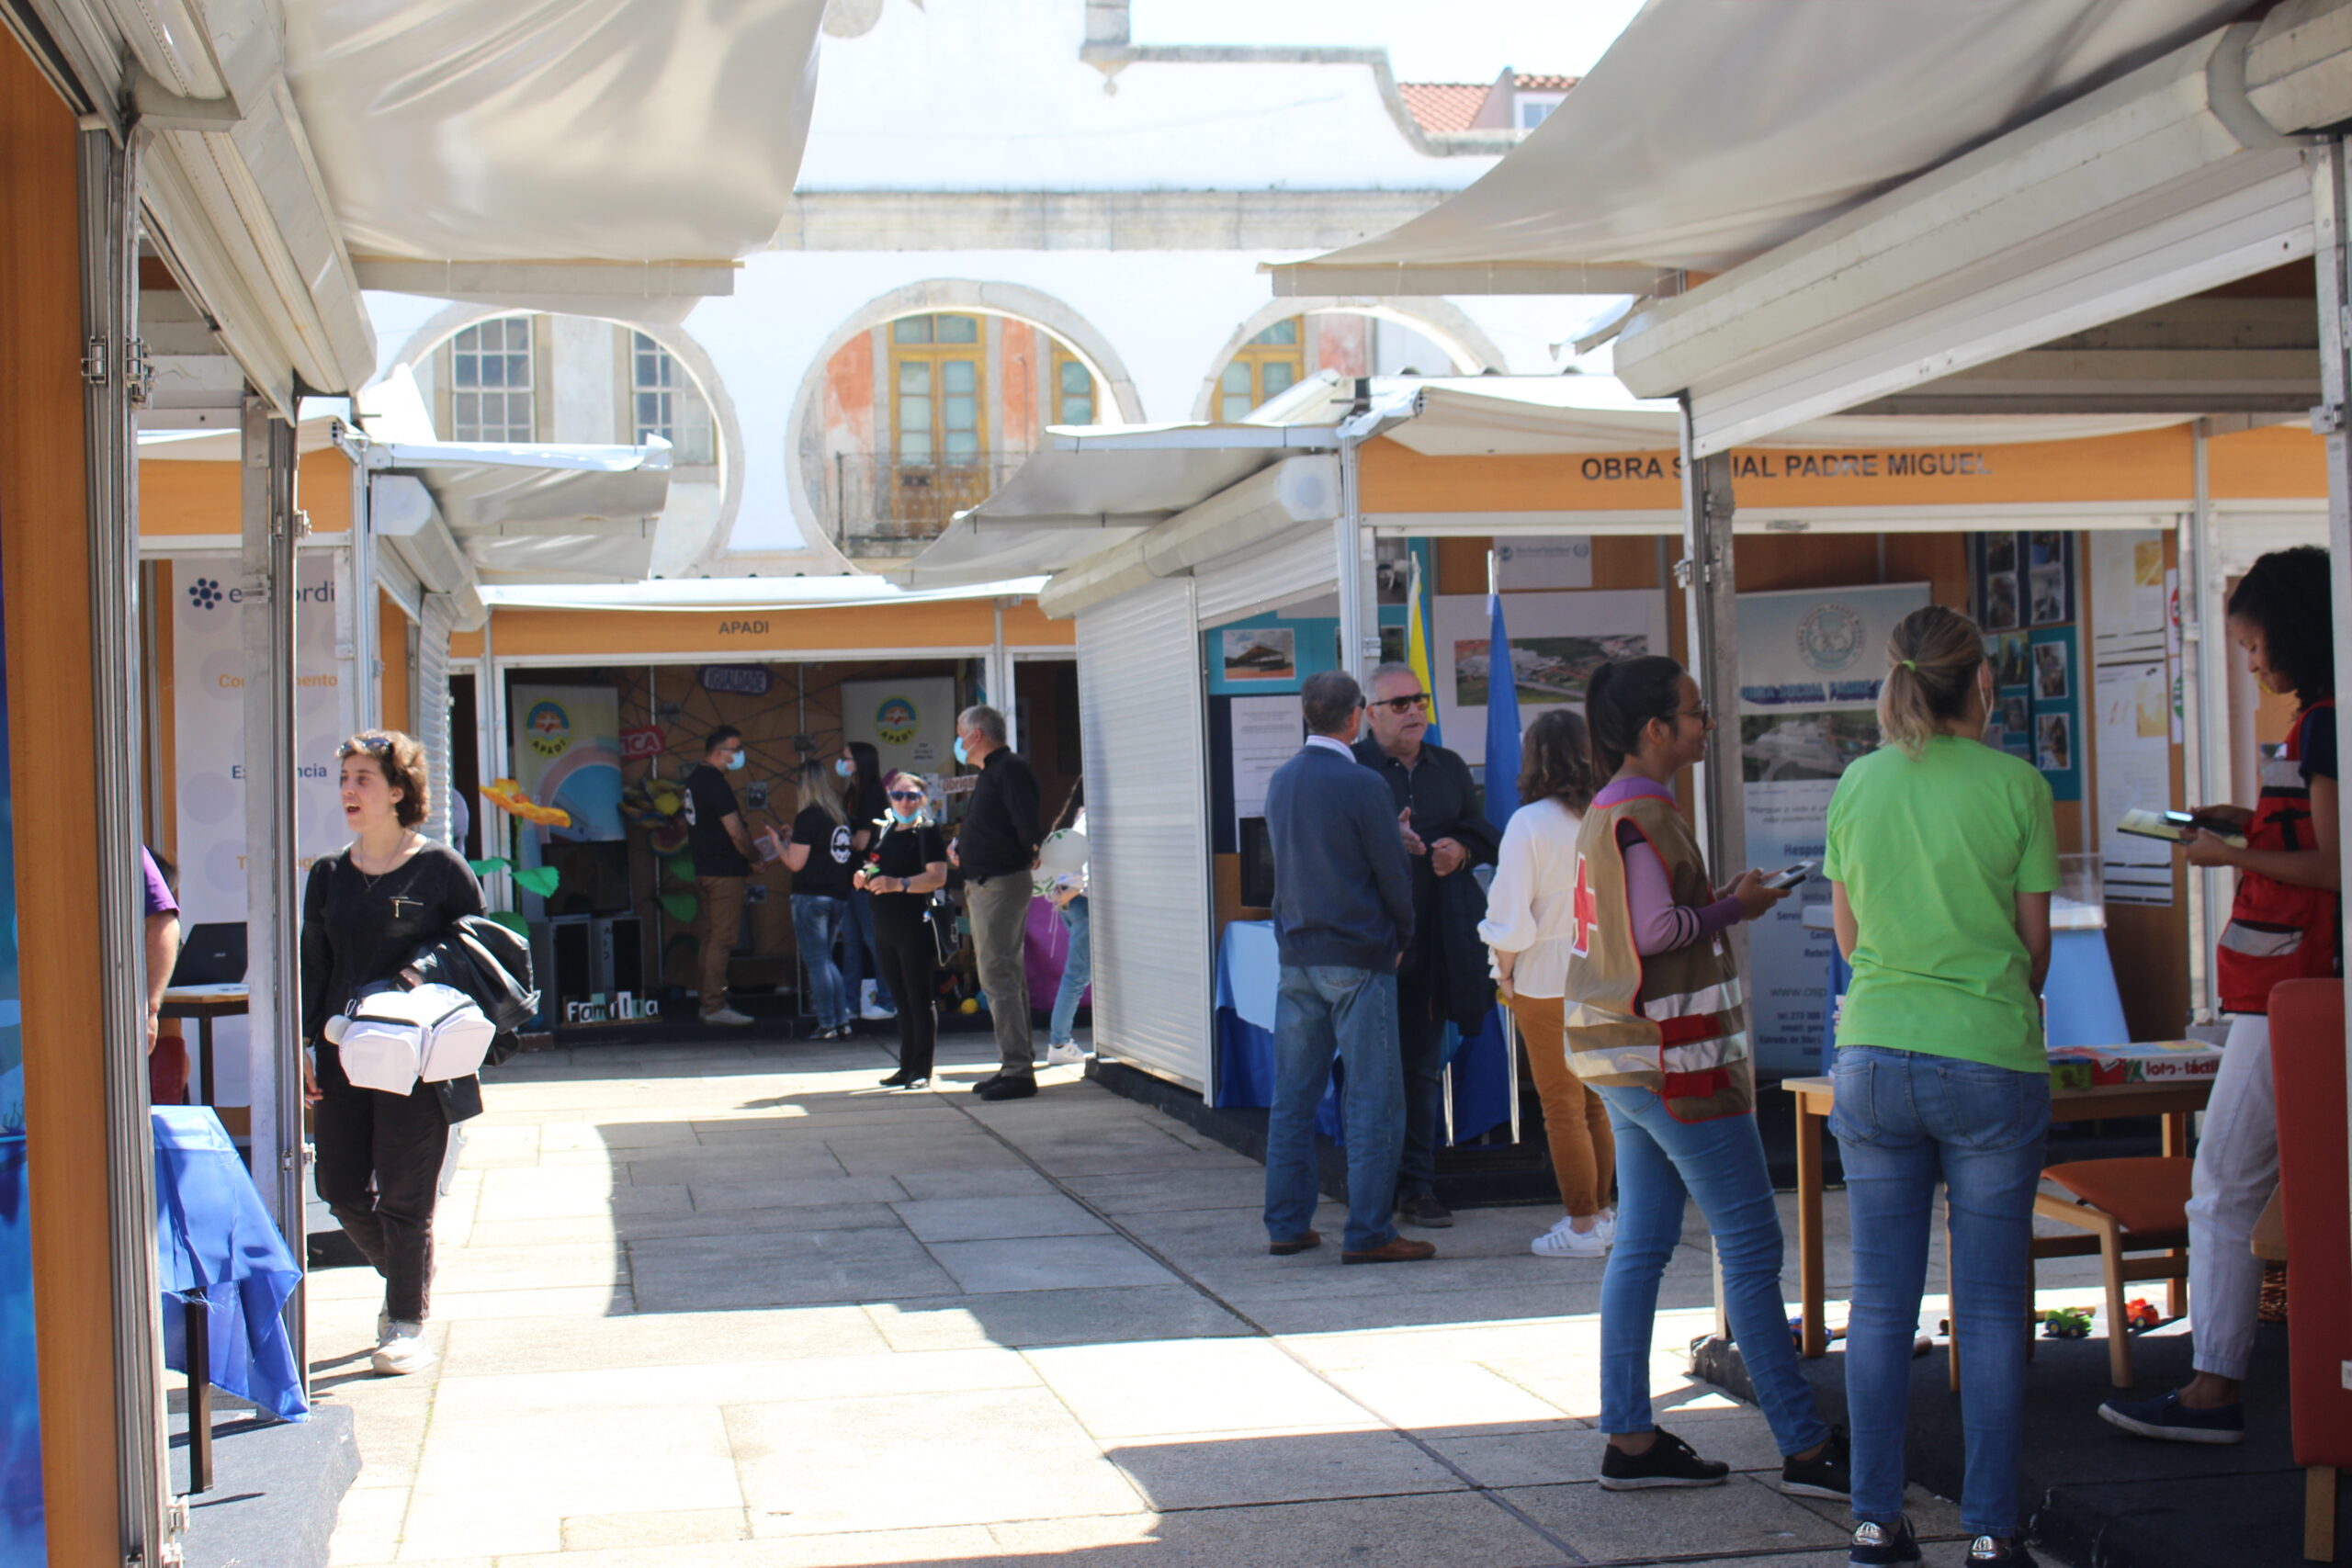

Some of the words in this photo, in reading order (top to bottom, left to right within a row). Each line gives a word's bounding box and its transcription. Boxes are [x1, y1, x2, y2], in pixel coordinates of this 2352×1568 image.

[1581, 457, 1664, 480] OBRA
[1672, 456, 1777, 479] SIAL
[1785, 454, 1879, 478] PADRE
[1887, 452, 1993, 476] MIGUEL
[718, 620, 770, 636] APADI
[533, 739, 567, 755] APADI
